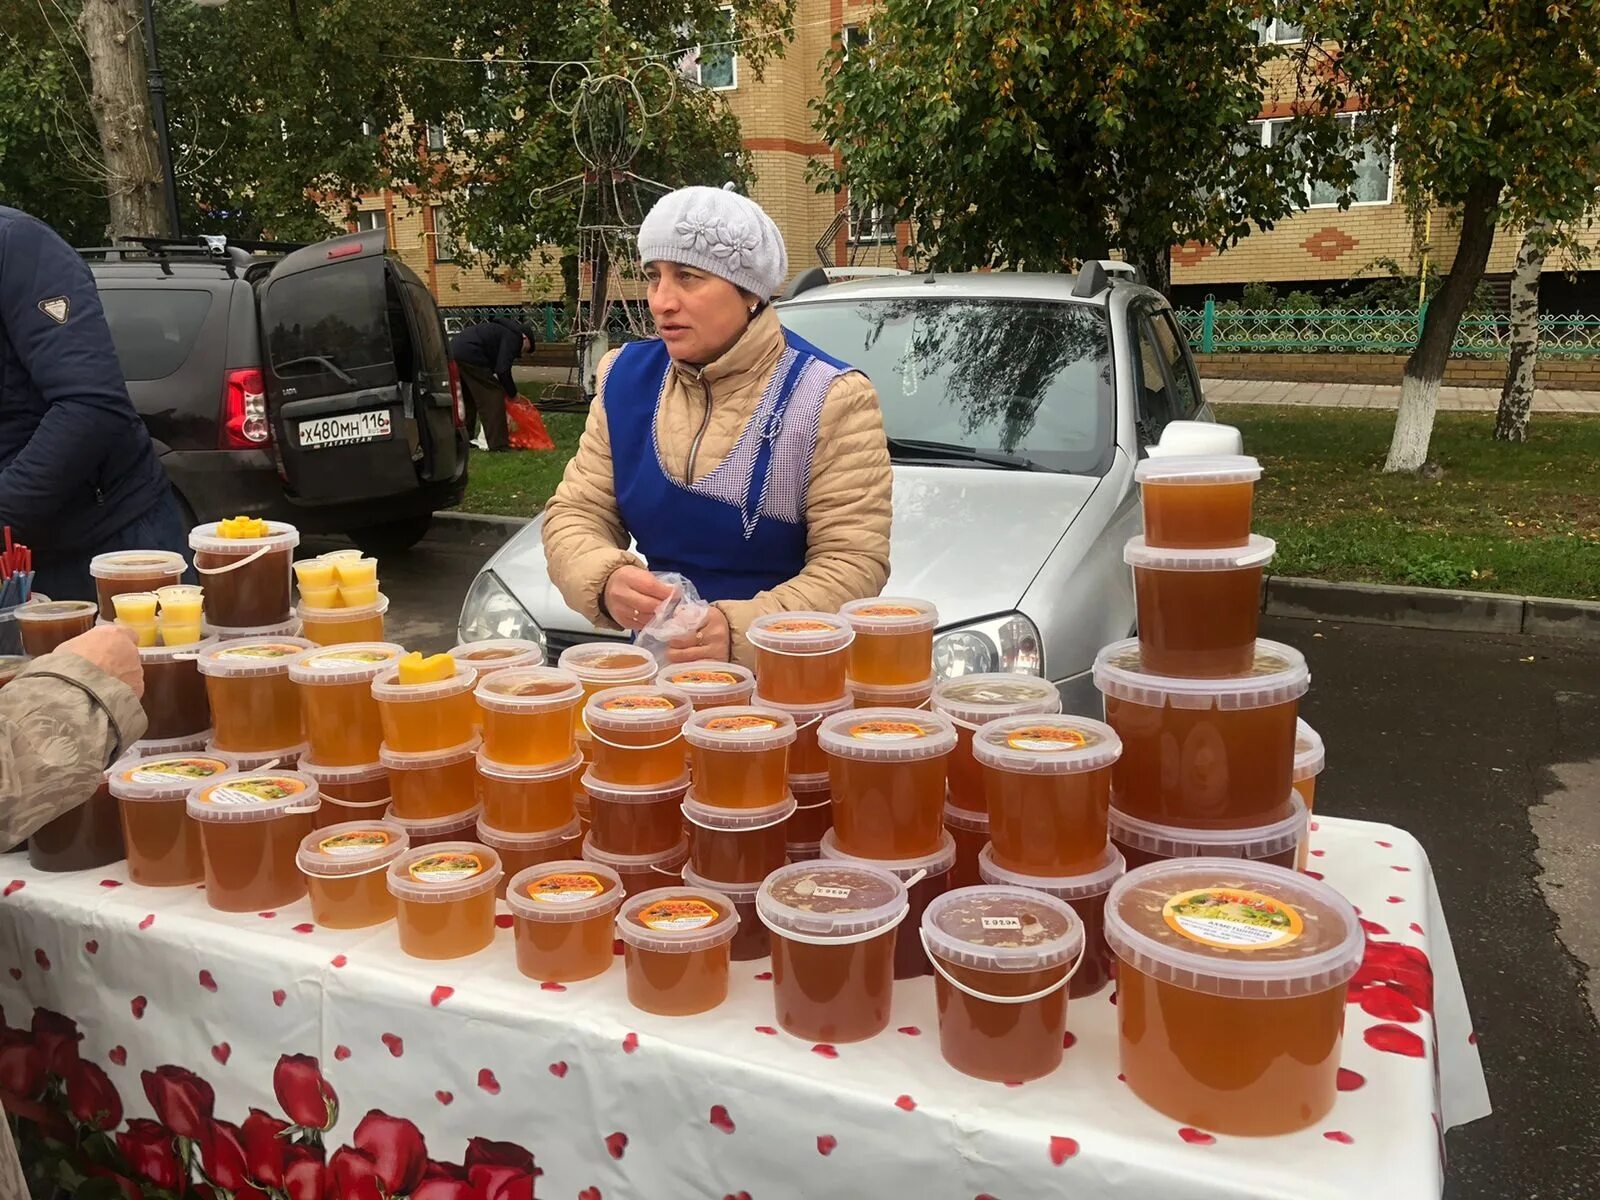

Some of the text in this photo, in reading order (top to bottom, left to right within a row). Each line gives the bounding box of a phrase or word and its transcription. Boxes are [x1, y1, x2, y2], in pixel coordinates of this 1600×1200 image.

[305, 413, 385, 443] Х480МН 116
[323, 437, 373, 448] ТАТАРСТАН
